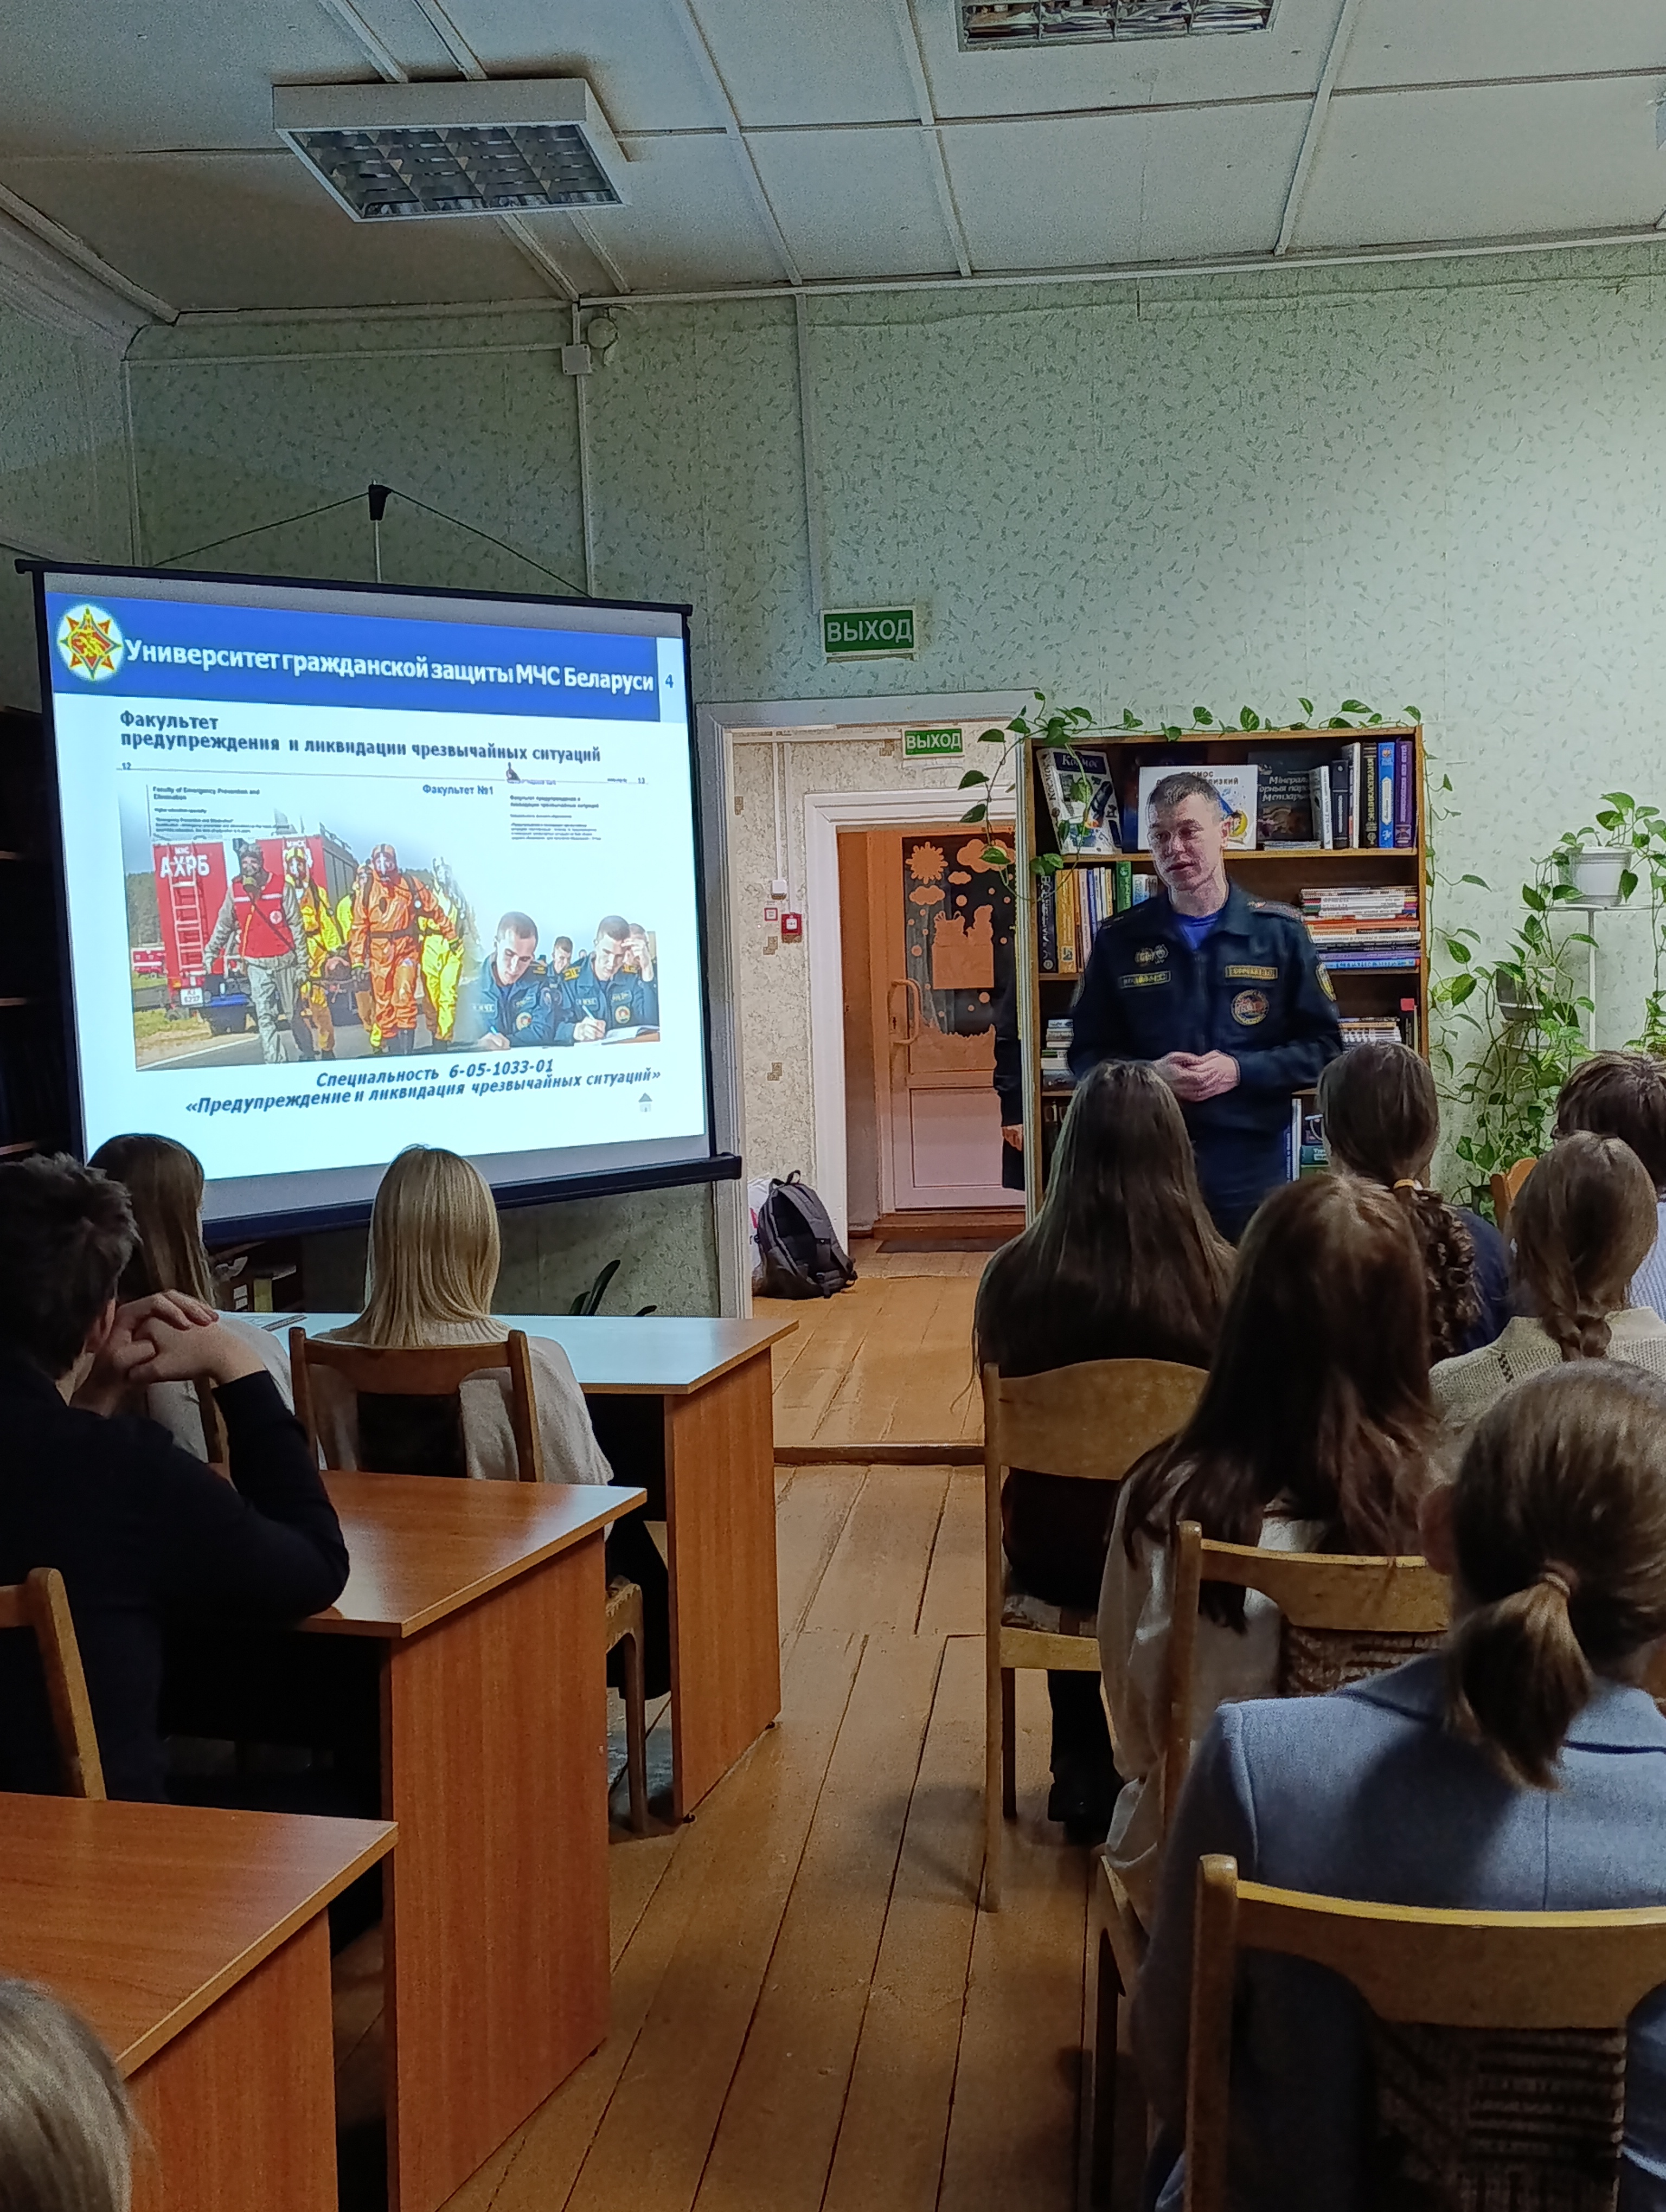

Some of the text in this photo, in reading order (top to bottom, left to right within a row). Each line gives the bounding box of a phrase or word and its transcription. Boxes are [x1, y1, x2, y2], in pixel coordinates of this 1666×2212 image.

[826, 619, 912, 644] ВЫХОД
[125, 639, 654, 695] Университет гражданской защиты МЧС Беларуси
[665, 674, 674, 689] 4
[120, 710, 219, 731] Факультет
[120, 733, 601, 764] предупреждения и ликвидации чрезвычайных ситуаций
[906, 732, 962, 750] ВЫХОД
[422, 784, 494, 796] Факультет №1
[316, 1058, 554, 1088] Специальность 6-05-1033-01
[185, 1067, 661, 1116] «Предупреждение и ликвидация чрезвычайных ситуаций»
